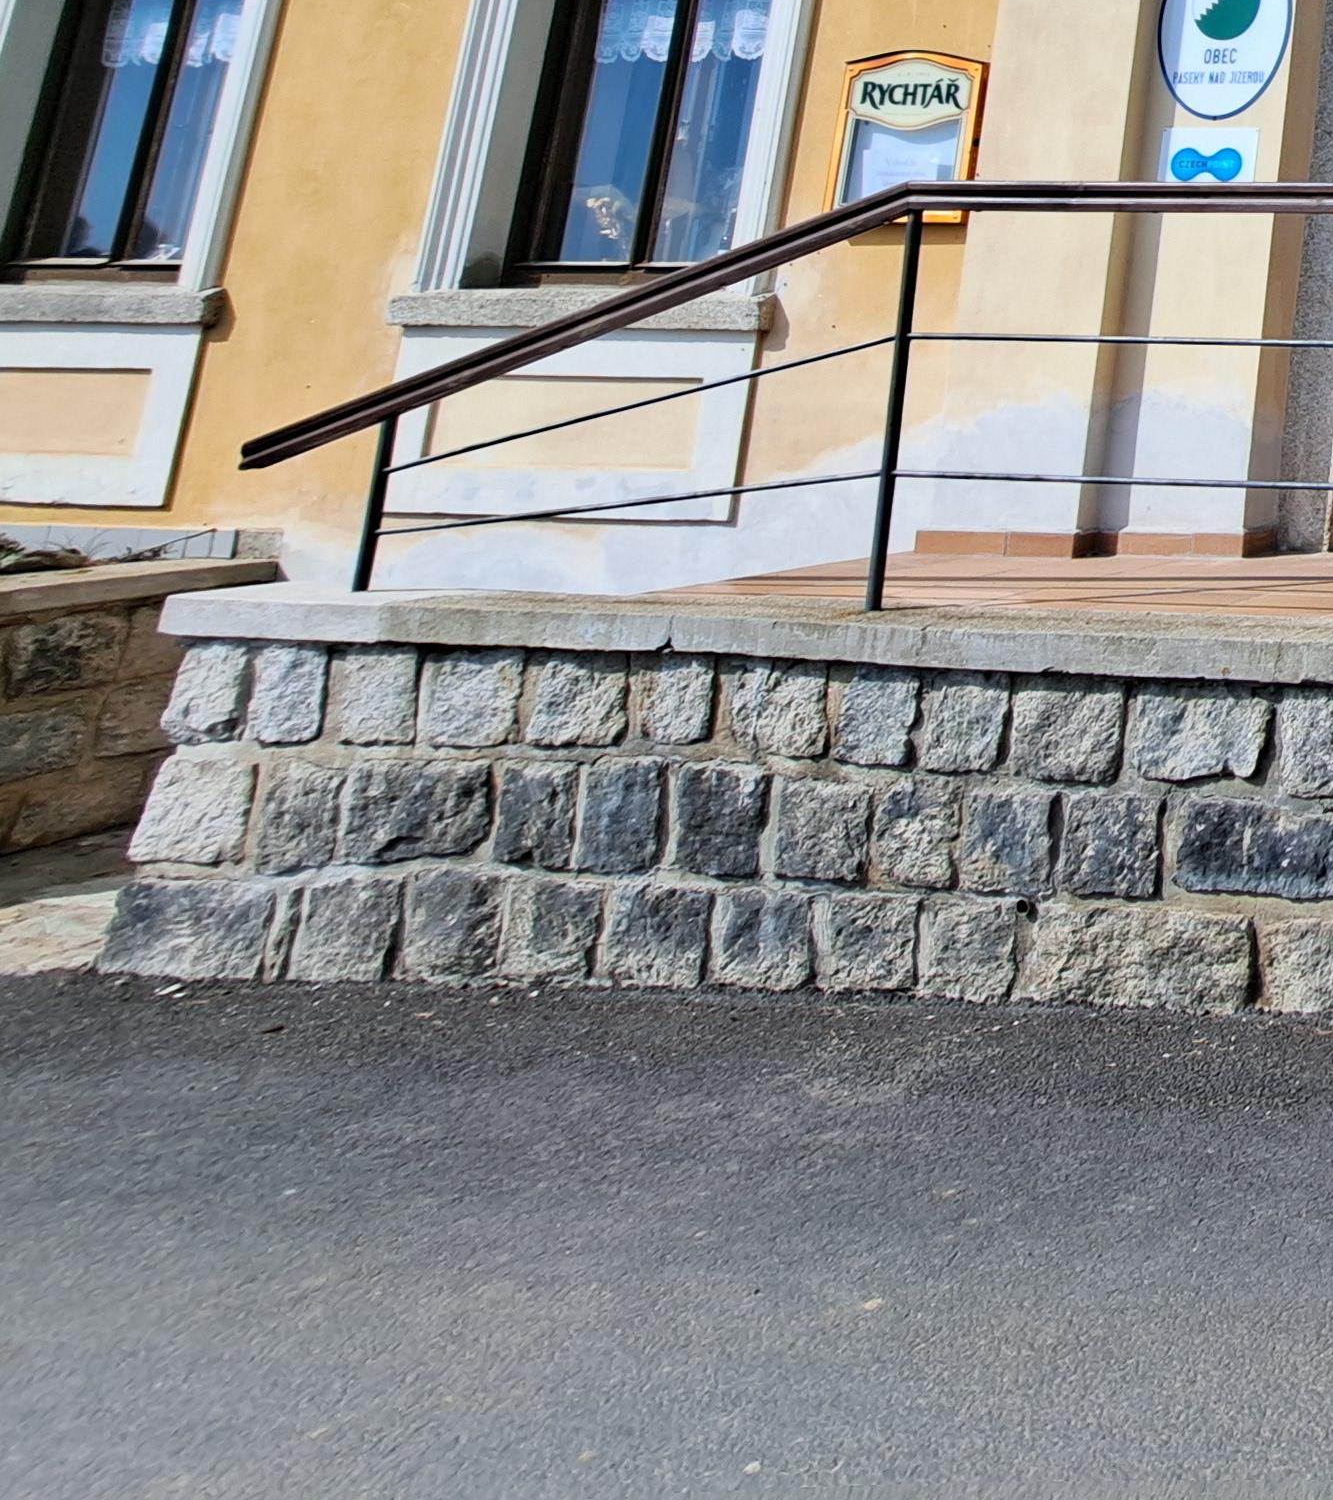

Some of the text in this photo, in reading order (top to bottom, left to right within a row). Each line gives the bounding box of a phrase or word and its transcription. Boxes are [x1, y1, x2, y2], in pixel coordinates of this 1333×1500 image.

[1203, 48, 1238, 65] OBEC
[1172, 70, 1265, 84] PASEKY NAD JIZEROU
[860, 77, 965, 111] RYCHTÁŘ
